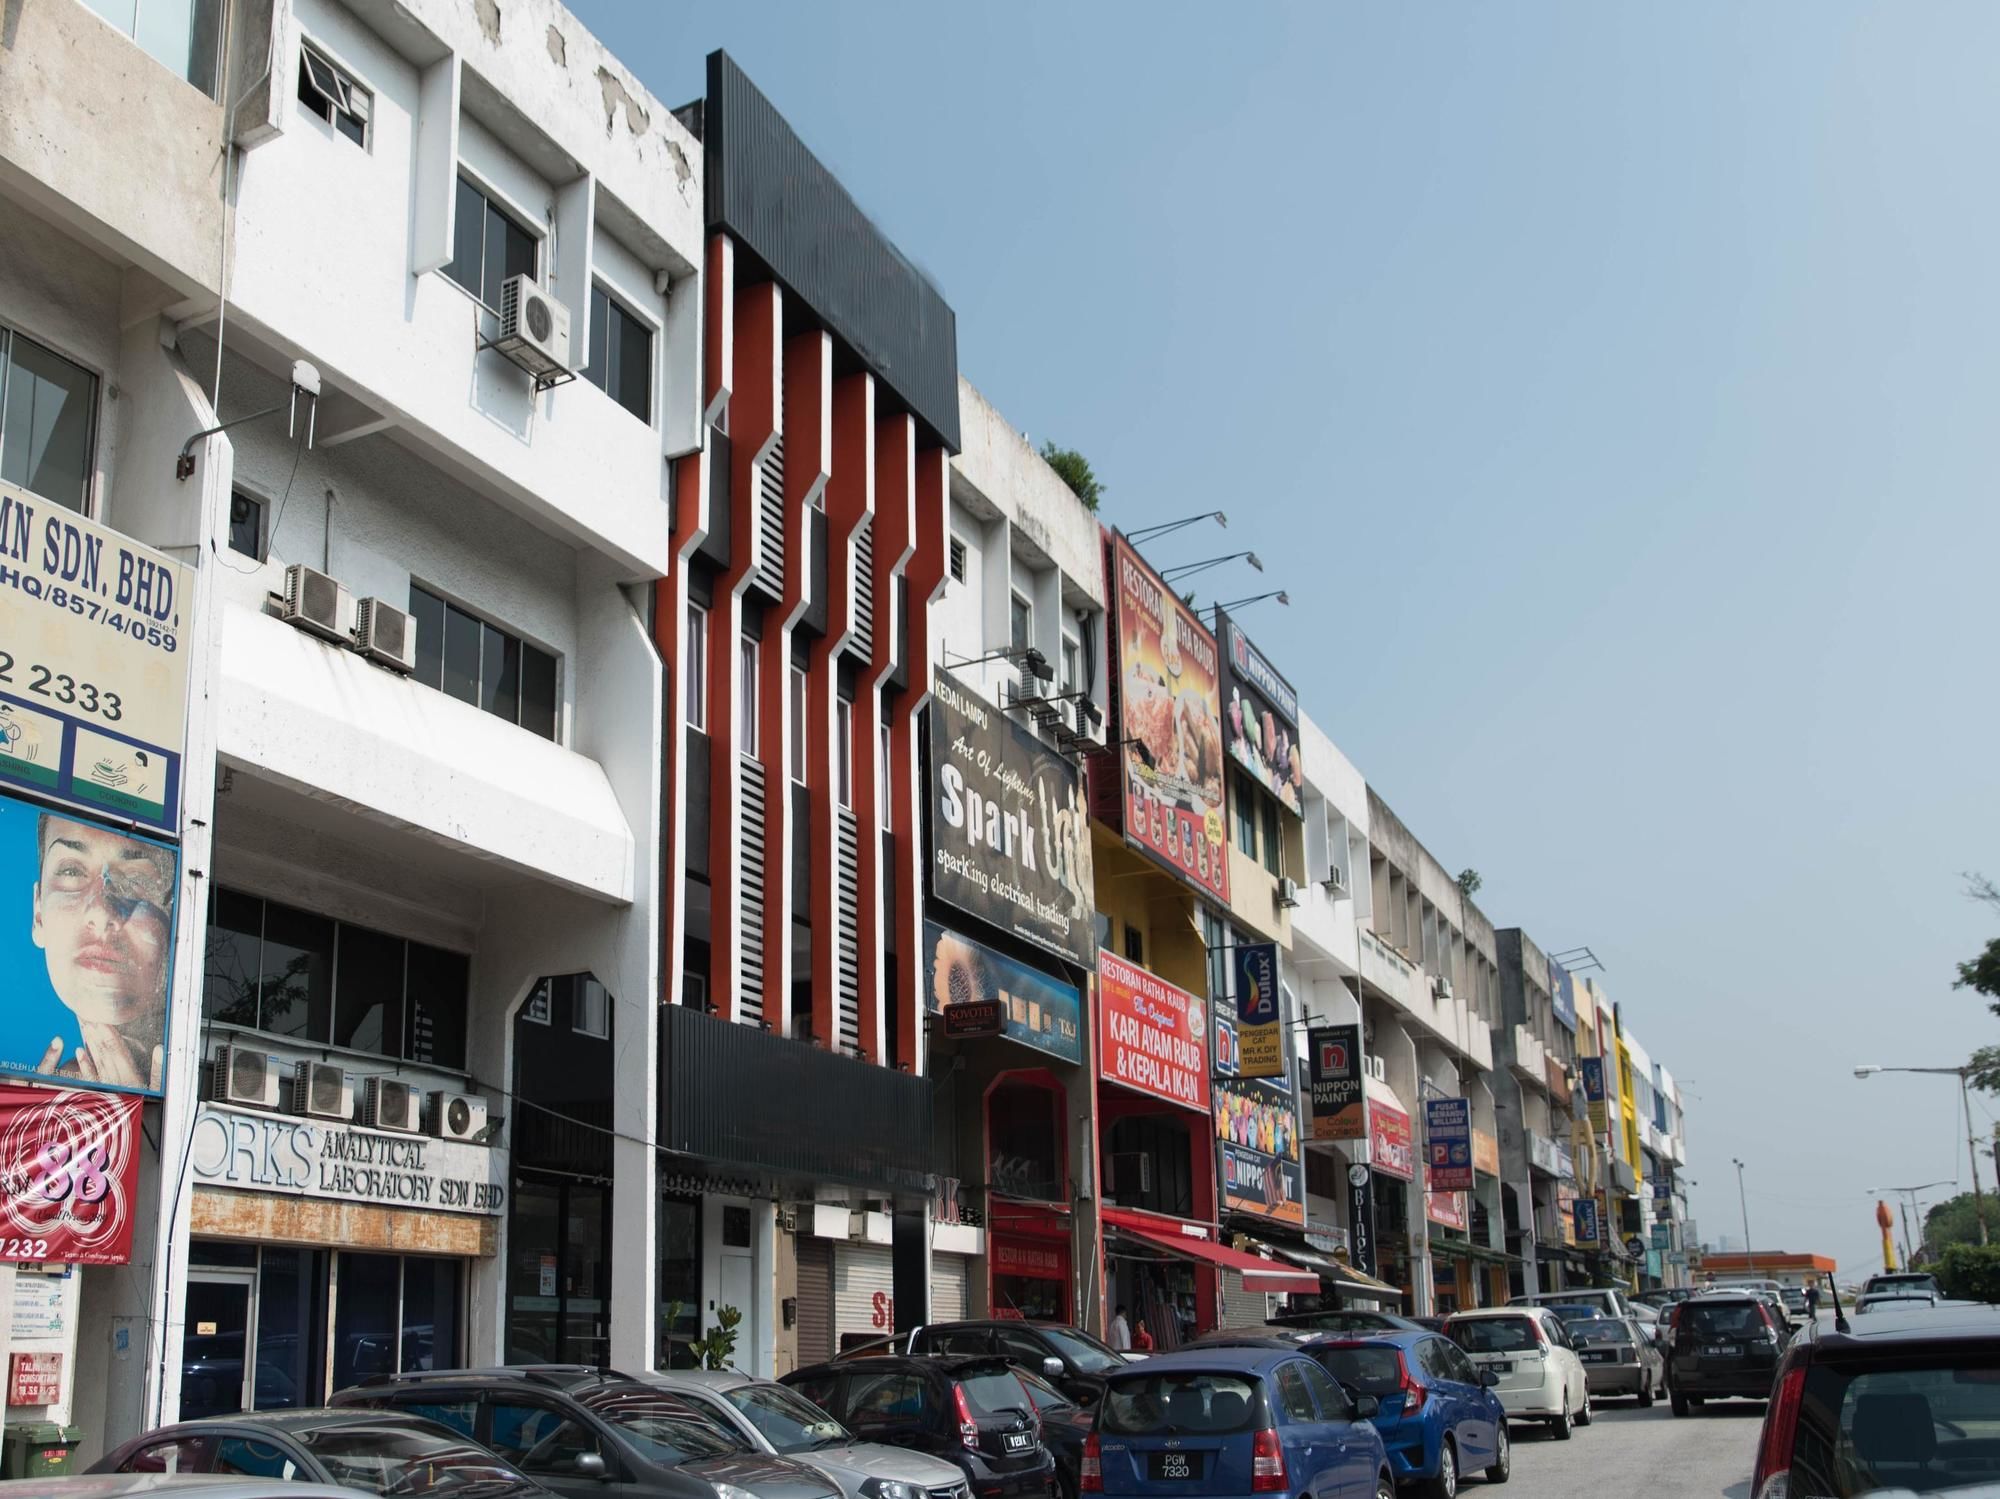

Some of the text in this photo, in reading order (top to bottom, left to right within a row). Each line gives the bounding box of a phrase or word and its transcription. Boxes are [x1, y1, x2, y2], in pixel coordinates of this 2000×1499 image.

[43, 516, 108, 598] SDN.
[115, 547, 180, 628] BHD.
[0, 564, 177, 653] HQ/857/4/059
[1193, 632, 1215, 677] RAUB
[28, 664, 123, 722] 2333
[935, 678, 989, 731] KEDAI LAMPU
[1248, 652, 1298, 719] NIPPON PAINT
[951, 735, 975, 761] Art
[977, 749, 992, 777] Of
[941, 763, 1037, 872] Spark
[990, 872, 1036, 913] electrical
[1036, 898, 1070, 935] trading
[1101, 956, 1142, 991] RESTORAN
[1142, 977, 1166, 1004] RATHA
[1166, 989, 1186, 1014] RAUB
[1257, 956, 1273, 1015] Dulux
[1109, 1009, 1140, 1051] KARI
[1141, 1023, 1173, 1062] AYAM
[1173, 1036, 1201, 1073] RAUB
[1239, 1028, 1279, 1038] PENGEDAR
[1252, 1036, 1267, 1045] CAT
[1264, 1045, 1278, 1054] DIY
[1117, 1046, 1199, 1103] & KEPALA IKAN
[1242, 1055, 1278, 1065] TRADING
[1313, 1079, 1360, 1093] NIPPON
[1313, 1092, 1349, 1105] PAINT
[1327, 1117, 1359, 1127] Colour
[35, 1142, 110, 1204] 88
[320, 1130, 426, 1170] ANALYTICAL
[319, 1162, 505, 1210] LABORATORY SDN BHD
[1236, 1159, 1266, 1192] NIPPO
[1162, 1465, 1190, 1477] 7320
[1165, 1454, 1186, 1466] PGW
